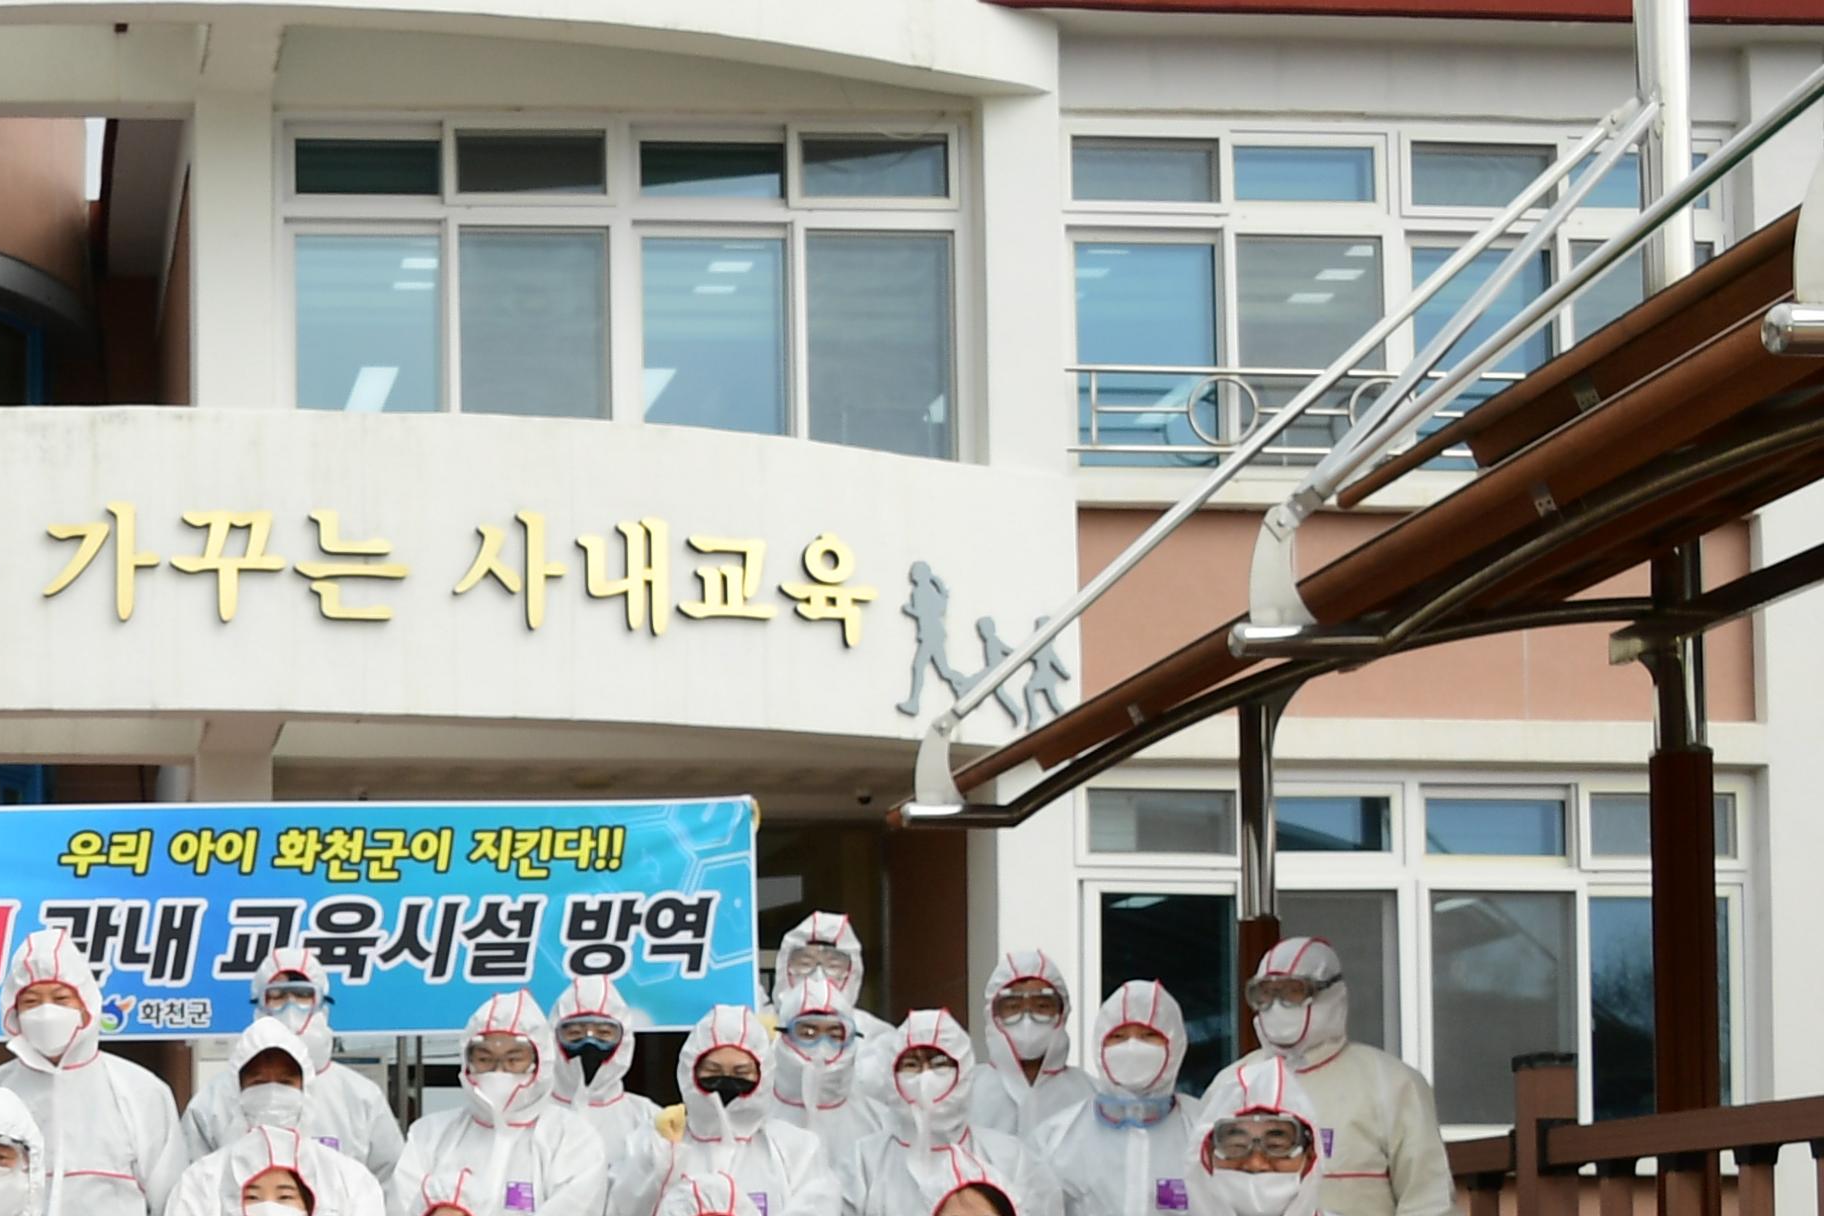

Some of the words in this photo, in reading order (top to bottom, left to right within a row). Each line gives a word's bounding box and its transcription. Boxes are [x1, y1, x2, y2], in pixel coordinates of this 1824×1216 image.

[43, 501, 409, 623] 가꾸는
[453, 510, 879, 648] 사내교육
[61, 829, 151, 876] 우리
[169, 829, 256, 874] 아이
[273, 827, 451, 881] 화천군이
[469, 826, 626, 879] 지킨다!!
[219, 898, 536, 980] 교육시설
[565, 897, 714, 977] 방역
[140, 1001, 210, 1026] 화천군
